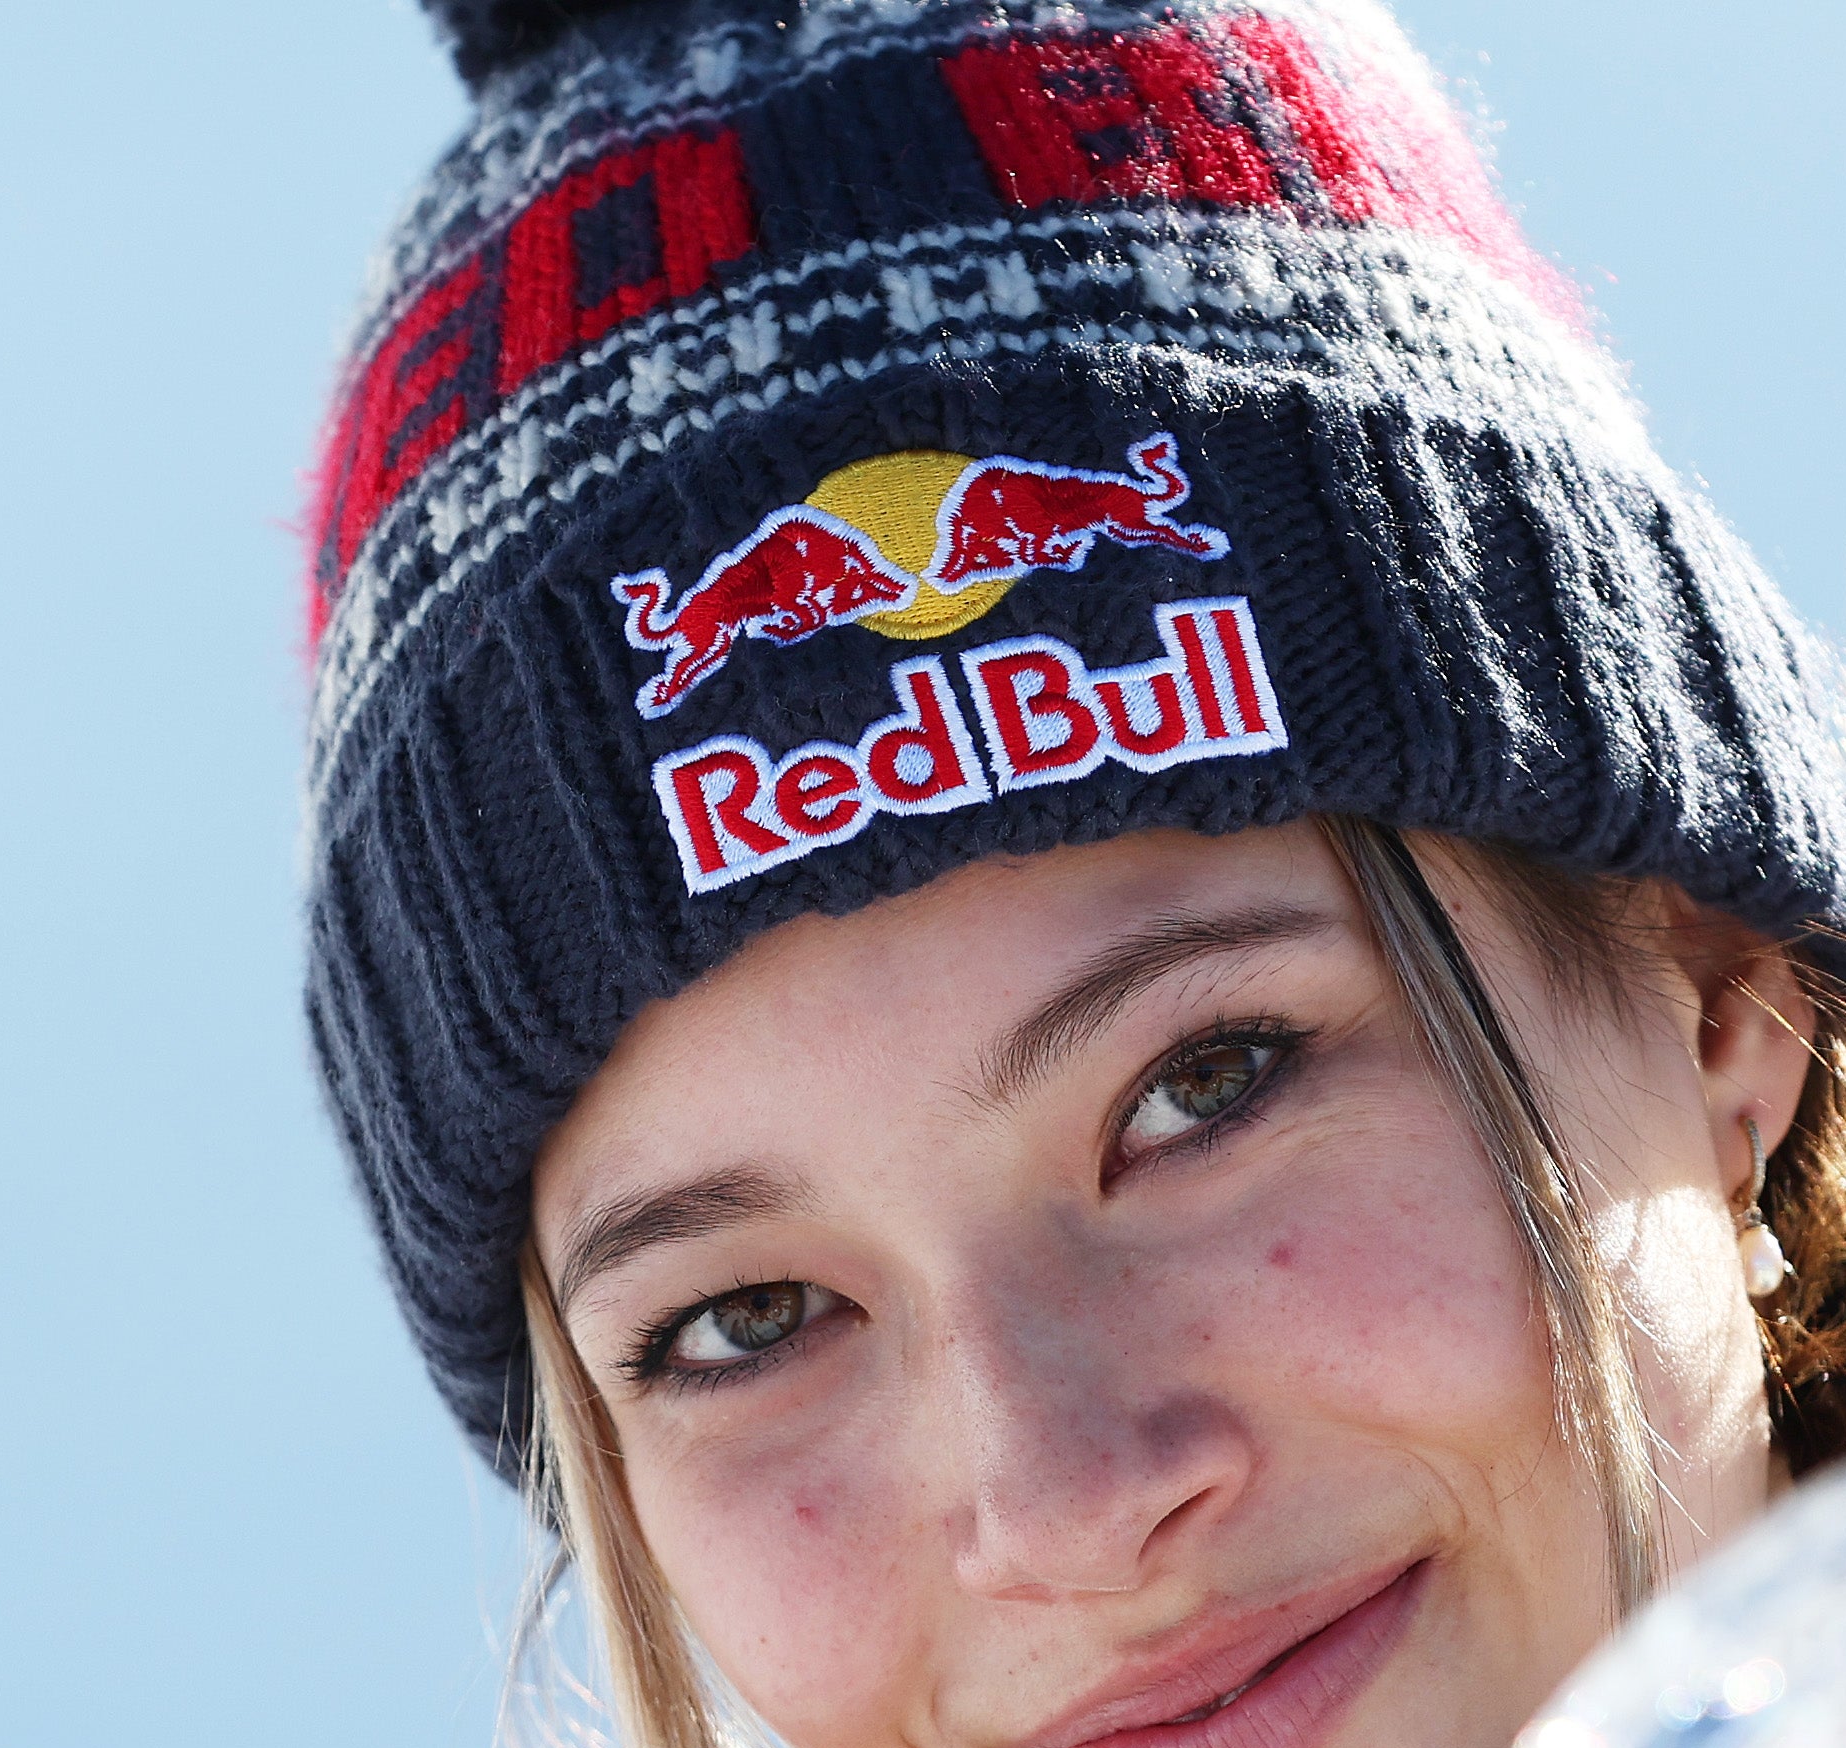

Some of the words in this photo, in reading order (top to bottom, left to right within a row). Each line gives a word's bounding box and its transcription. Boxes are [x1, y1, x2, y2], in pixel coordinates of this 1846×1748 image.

[310, 125, 755, 640] ED
[651, 656, 990, 897] Red
[960, 595, 1288, 794] Bull
